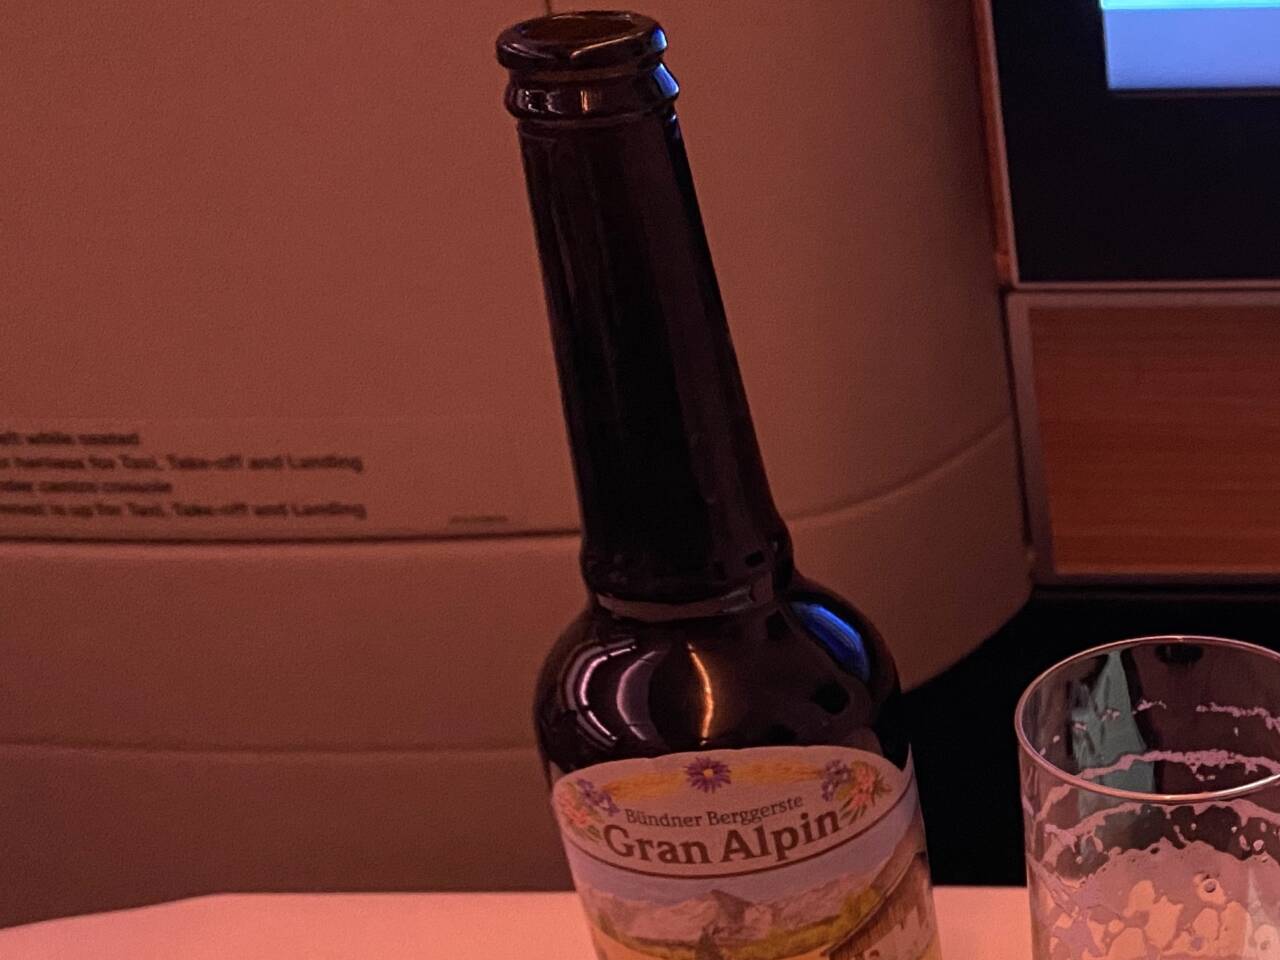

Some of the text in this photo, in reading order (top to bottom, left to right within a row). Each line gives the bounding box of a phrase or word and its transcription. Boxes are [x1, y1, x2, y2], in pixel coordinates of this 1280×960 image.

[625, 796, 803, 828] Bündner Berggerste
[603, 810, 842, 865] Gran Alpin
